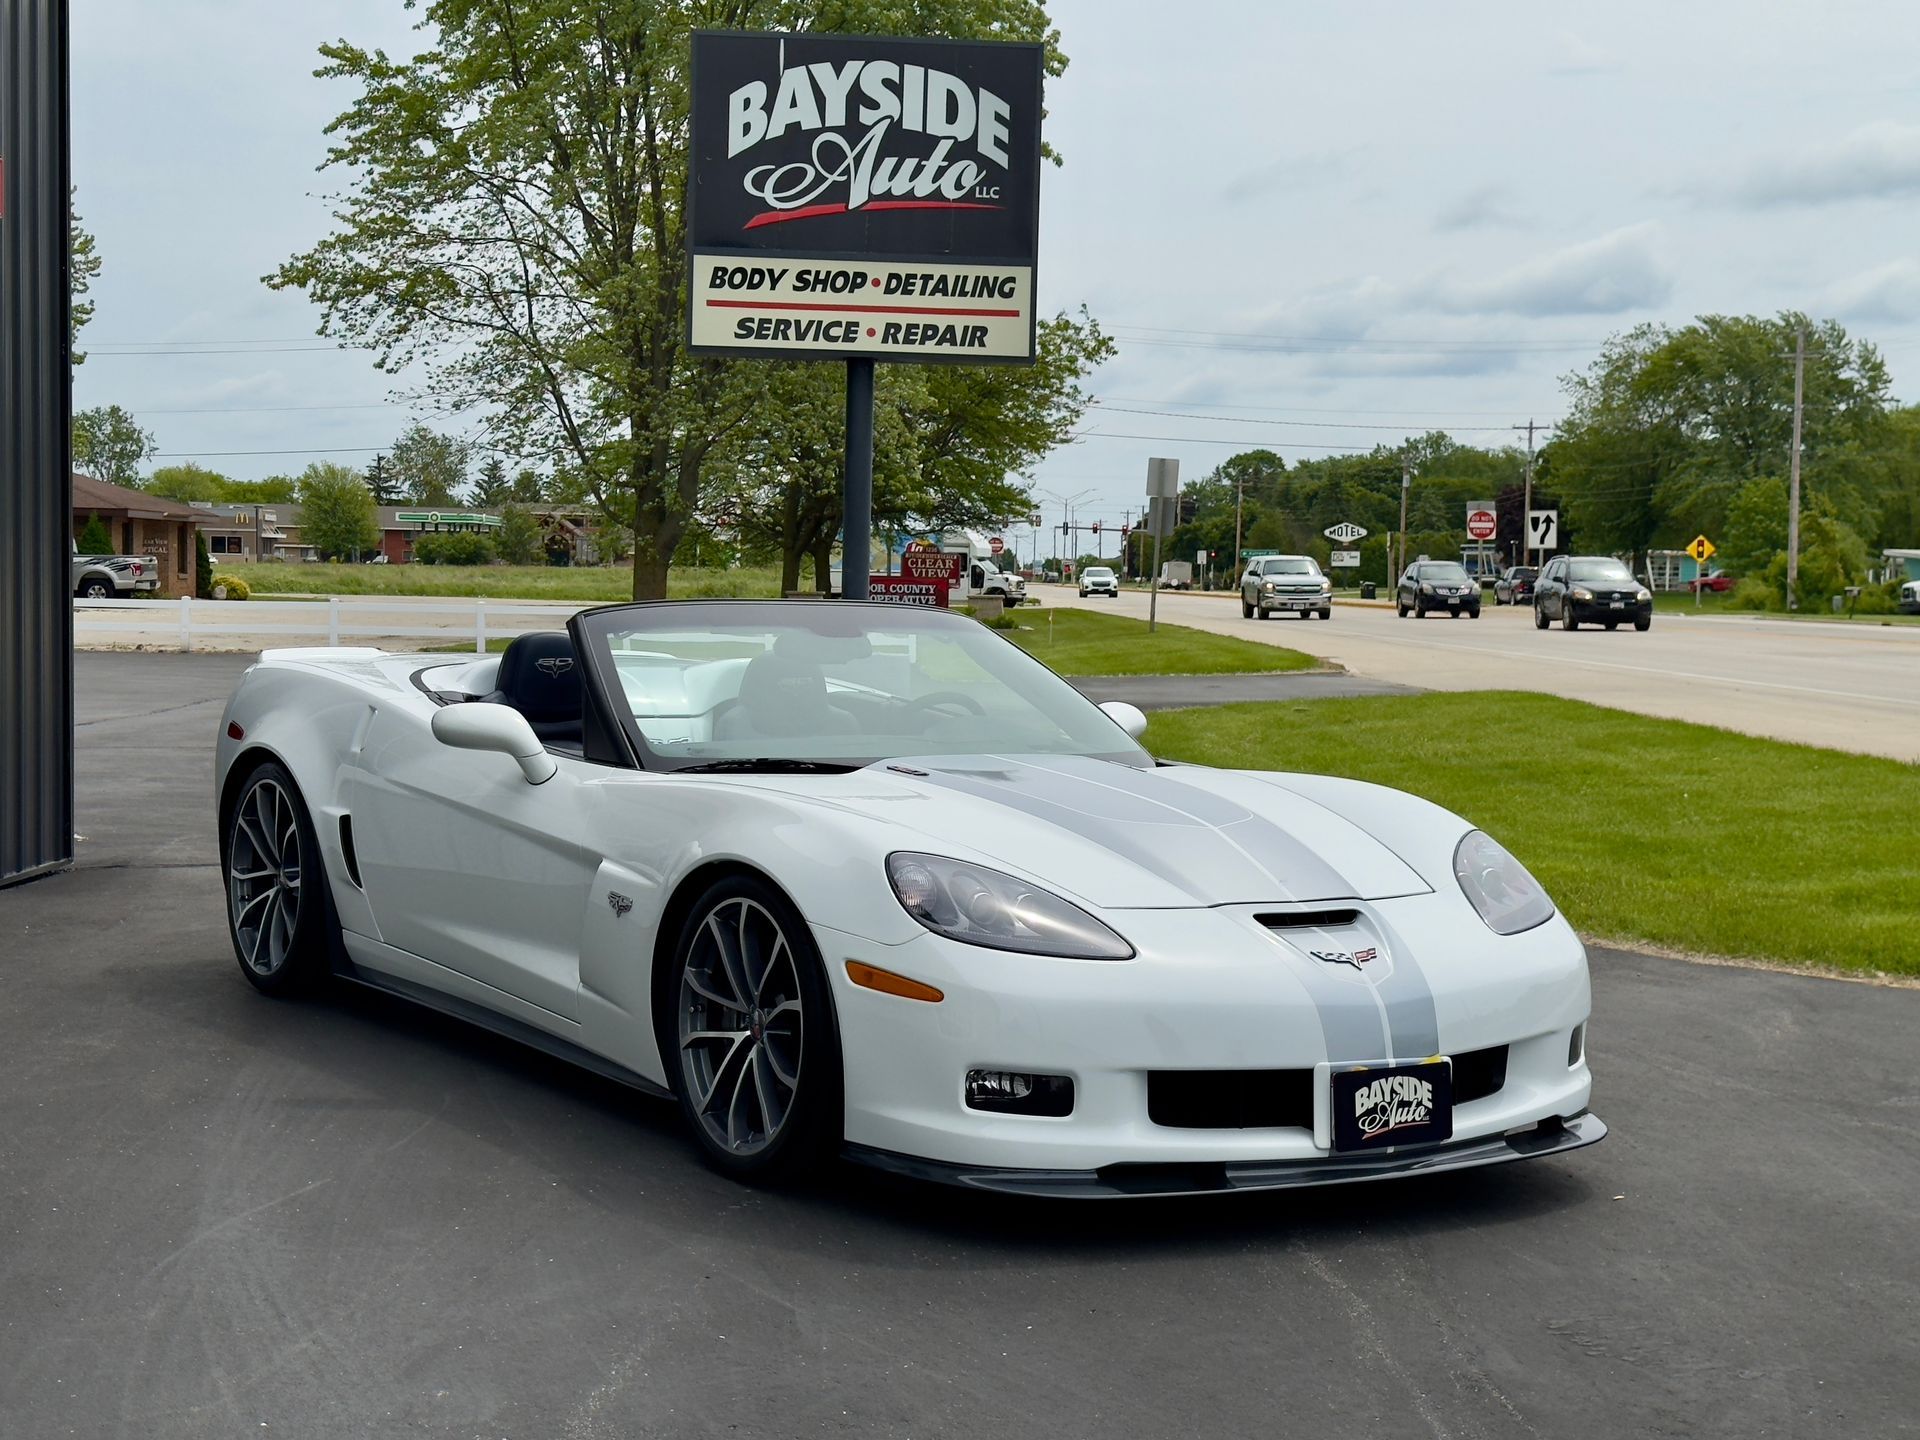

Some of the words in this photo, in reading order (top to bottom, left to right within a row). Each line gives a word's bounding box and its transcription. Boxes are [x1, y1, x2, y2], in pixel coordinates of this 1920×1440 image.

[728, 60, 1010, 170] BAYSIDE
[743, 115, 986, 210] Auto
[975, 186, 1000, 199] LLC
[709, 266, 788, 291] BODY
[792, 269, 868, 293] SHOP
[883, 274, 1017, 299] DETAILING
[734, 317, 860, 343] SERVICE
[881, 322, 989, 348] REPAIR
[1329, 525, 1362, 537] MOTEL
[908, 558, 954, 569] CLEAR
[912, 568, 951, 578] VIEW
[869, 584, 886, 593] OR
[889, 584, 936, 593] COUNTY
[869, 594, 936, 605] OPERATIVE
[1355, 1075, 1433, 1118] BAYSIDE
[1358, 1094, 1428, 1133] Auto
